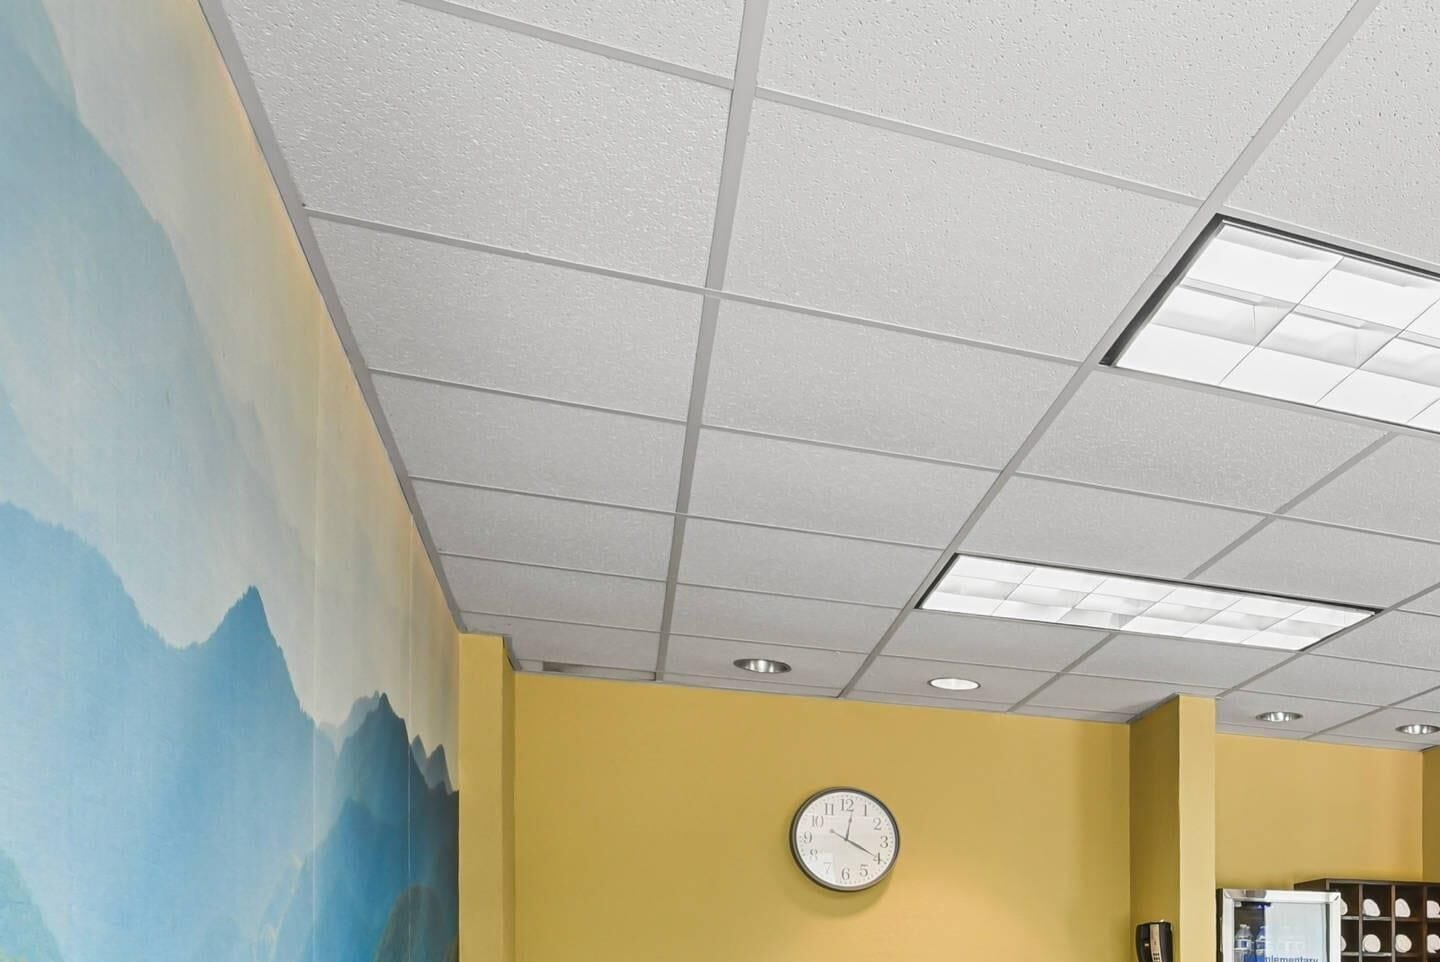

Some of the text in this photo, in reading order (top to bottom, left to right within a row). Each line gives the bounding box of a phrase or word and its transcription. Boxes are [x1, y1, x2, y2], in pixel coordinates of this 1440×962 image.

[824, 803, 834, 816] 11
[841, 799, 854, 812] 12
[863, 803, 868, 816] 1
[811, 815, 824, 828] 10
[873, 818, 882, 830] 2
[803, 831, 813, 844] 9
[880, 836, 889, 848] 3
[809, 849, 818, 861] 8
[873, 852, 882, 864] 4
[823, 862, 832, 874] 7
[841, 868, 850, 880] 6
[860, 864, 869, 877] 5
